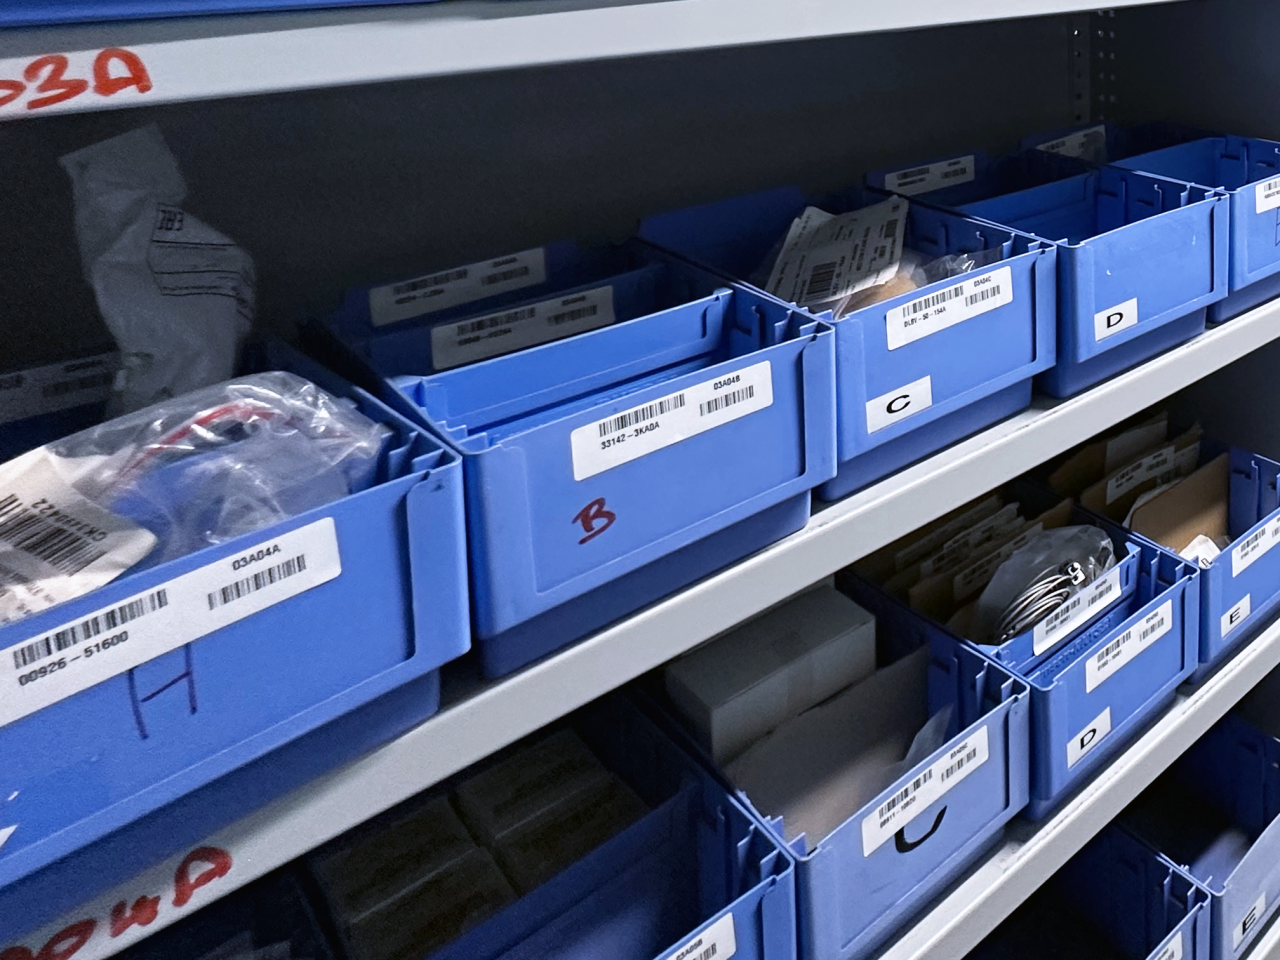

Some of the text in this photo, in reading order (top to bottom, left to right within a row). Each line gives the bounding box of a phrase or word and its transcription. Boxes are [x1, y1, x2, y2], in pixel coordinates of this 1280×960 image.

[1105, 311, 1124, 330] D
[886, 394, 911, 415] C
[572, 497, 617, 546] B
[232, 544, 282, 571] 03A04A
[1229, 606, 1241, 626] E
[1079, 727, 1097, 750] D
[1241, 906, 1257, 936] E
